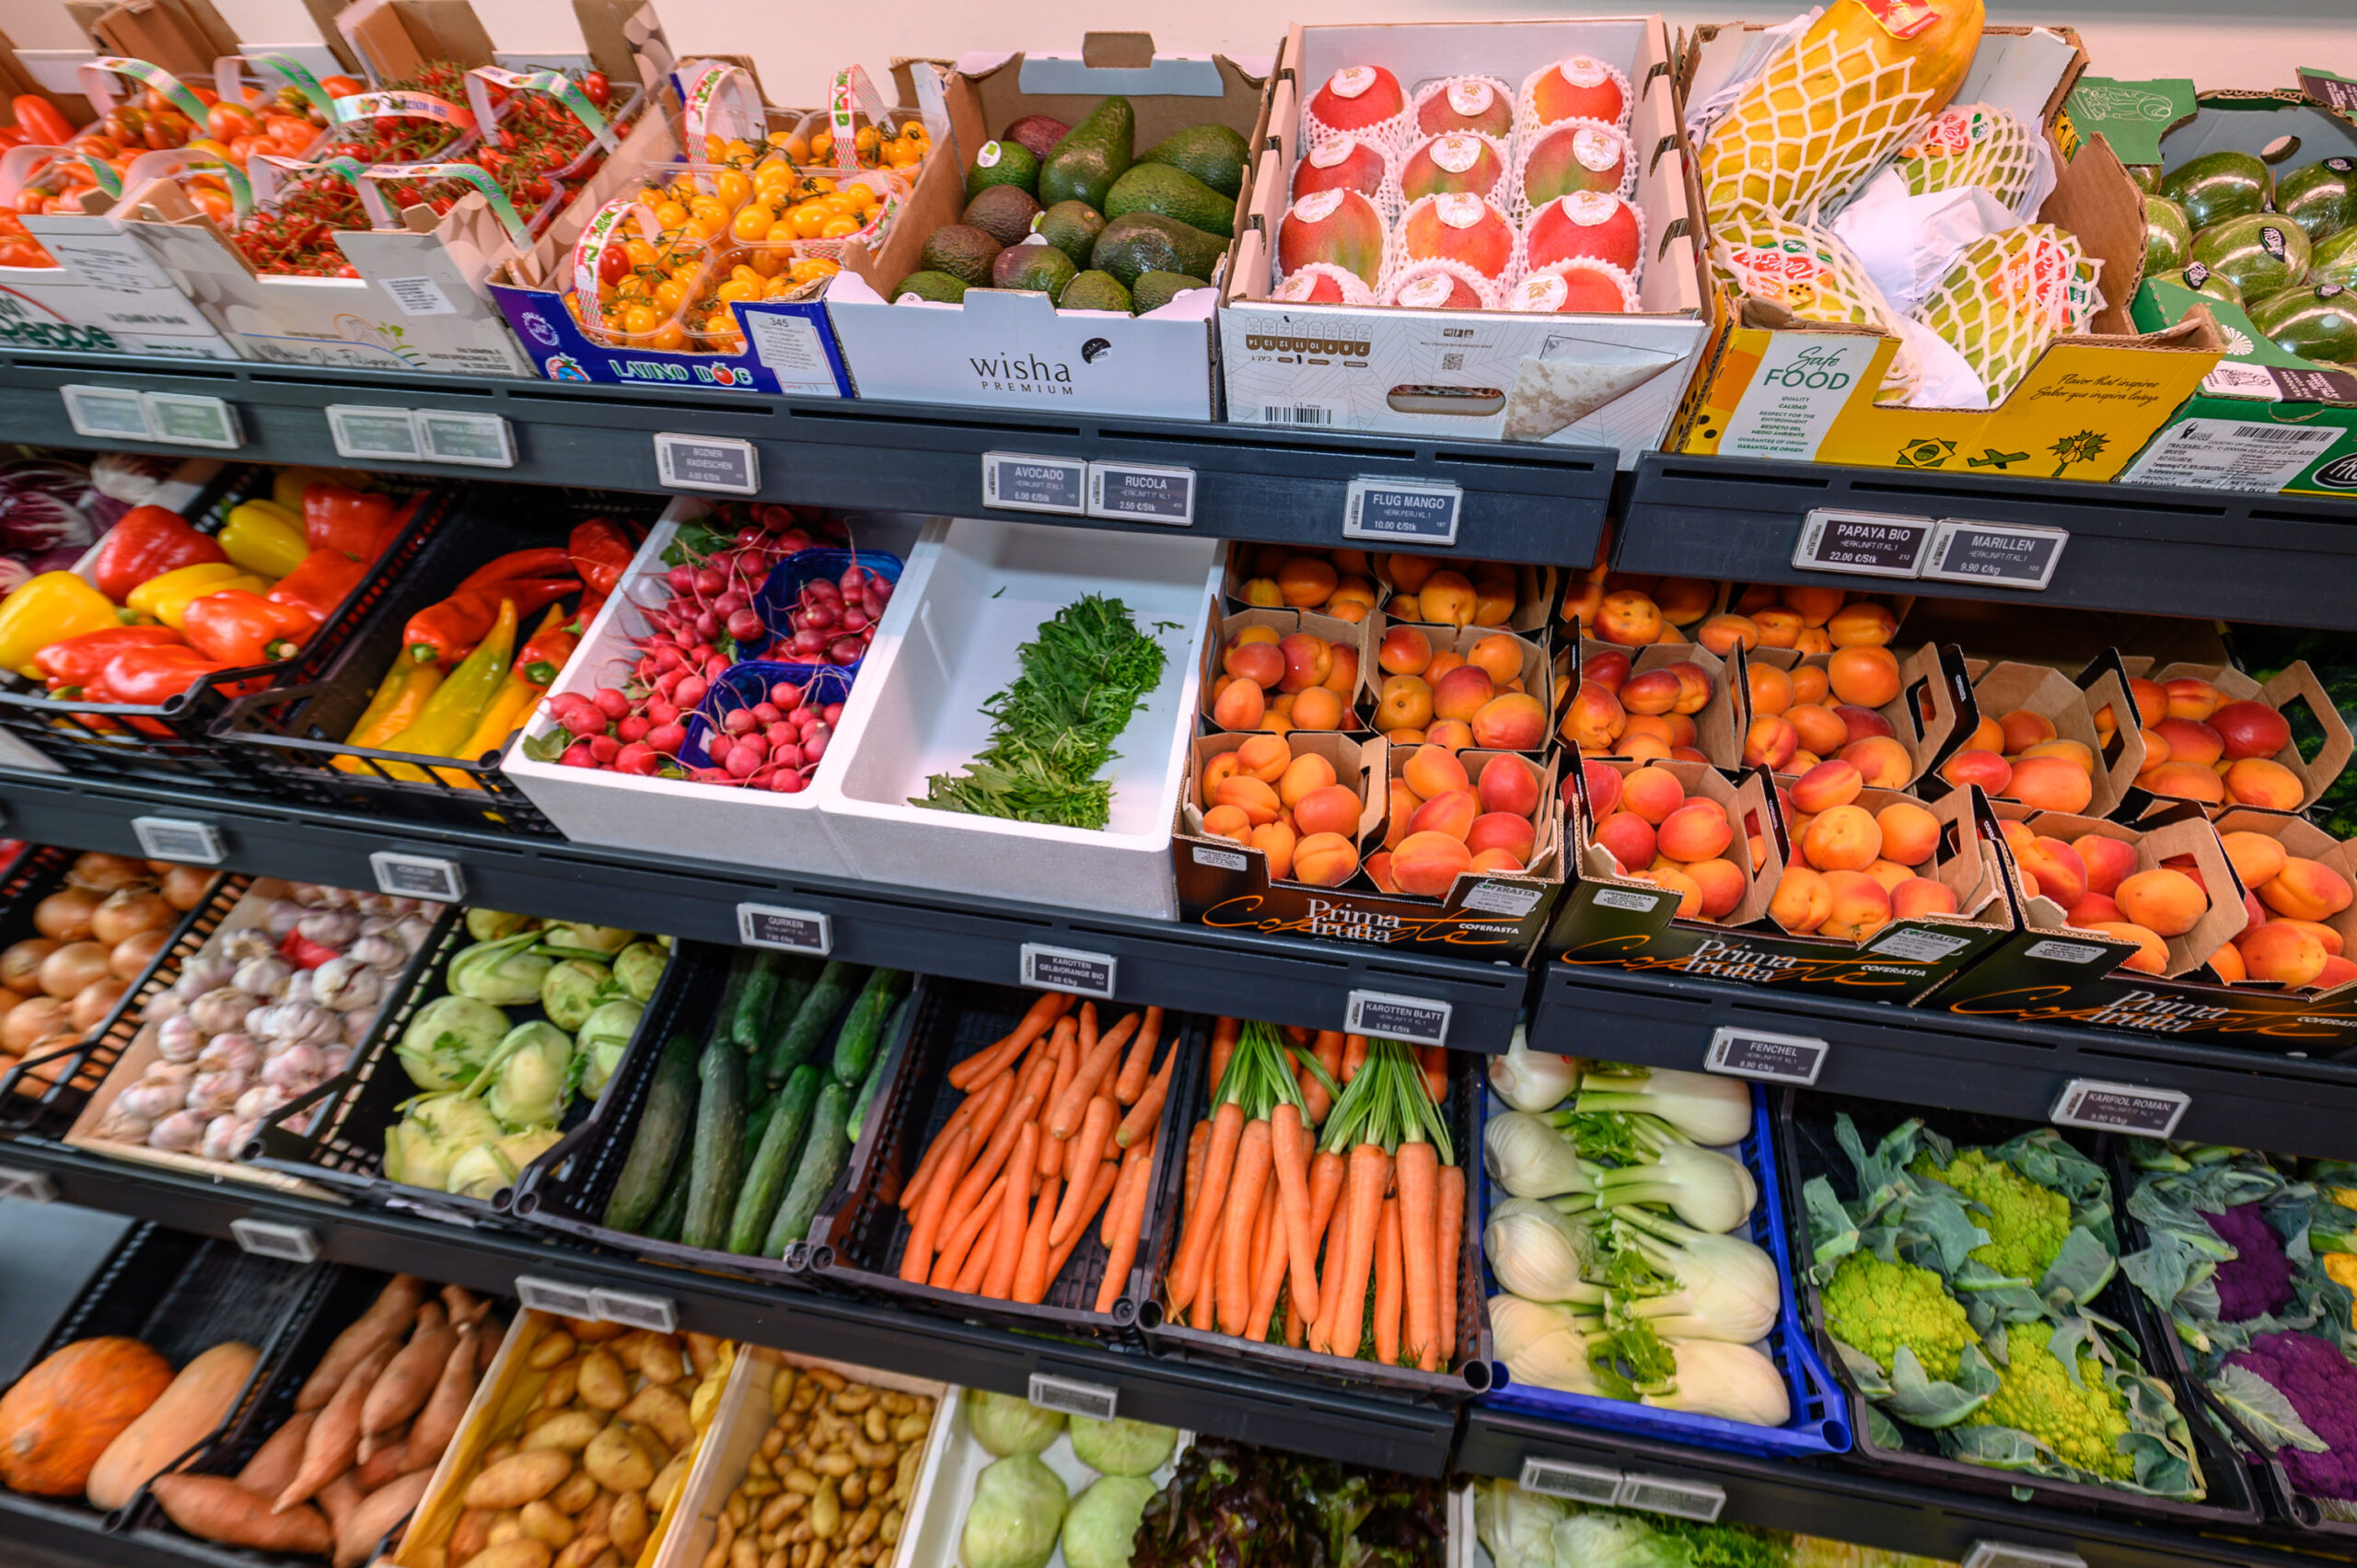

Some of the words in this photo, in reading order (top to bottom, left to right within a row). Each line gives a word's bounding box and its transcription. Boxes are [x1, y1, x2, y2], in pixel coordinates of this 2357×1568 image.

[769, 317, 789, 328] 345
[1248, 338, 1258, 346] 14
[1279, 340, 1289, 348] 12
[1785, 345, 1848, 373] Safe
[609, 359, 688, 381] LATINO
[970, 352, 1073, 383] wisha
[1762, 368, 1851, 390] FOOD
[2057, 373, 2093, 385] Flavor
[2092, 375, 2118, 386] that
[2117, 378, 2159, 391] inspires
[981, 380, 1073, 395] PREMIUM
[2065, 391, 2089, 402] que
[2089, 389, 2126, 403] inspira
[1015, 466, 1064, 481] AVOCADO
[1125, 475, 1167, 490] RUCOLA
[1015, 492, 1029, 501] 6.00
[1031, 493, 1051, 503] €/Stk
[1373, 494, 1401, 506] FLUG
[1404, 496, 1445, 509] MANGO
[1120, 501, 1135, 510] 2.50
[1136, 502, 1156, 512] €/Stk
[1374, 520, 1395, 530] 10.00
[1396, 521, 1417, 532] €/Stk
[1837, 524, 1886, 540] PAPAYA
[1887, 528, 1910, 541] BIO
[1971, 535, 2036, 552] MARILLEN
[1829, 552, 1853, 562] 22.00
[1854, 552, 1878, 564] €/Stk
[1960, 562, 1980, 573] 9.90
[1980, 563, 2002, 575] €/kg
[1476, 882, 1537, 898] COFERASTA
[1306, 898, 1401, 929] Prima
[768, 915, 804, 929] GURKEN
[1458, 923, 1519, 935] COFERASTA
[1308, 917, 1392, 943] frutta
[1689, 939, 1798, 969] Prima
[1052, 958, 1092, 970] KAROTTEN
[1684, 957, 1775, 983] frutta
[1860, 964, 1926, 977] COFERASTA
[1039, 964, 1090, 979] GELB/ORANGE
[1092, 971, 1105, 981] BIO
[2104, 989, 2229, 1019] Prima
[1365, 1003, 1412, 1016] KAROTTEN
[1413, 1009, 1443, 1021] BLATT
[2087, 1005, 2192, 1033] frutta
[1749, 1041, 1797, 1057] FENCHEL
[2088, 1092, 2131, 1107] KARFIOL
